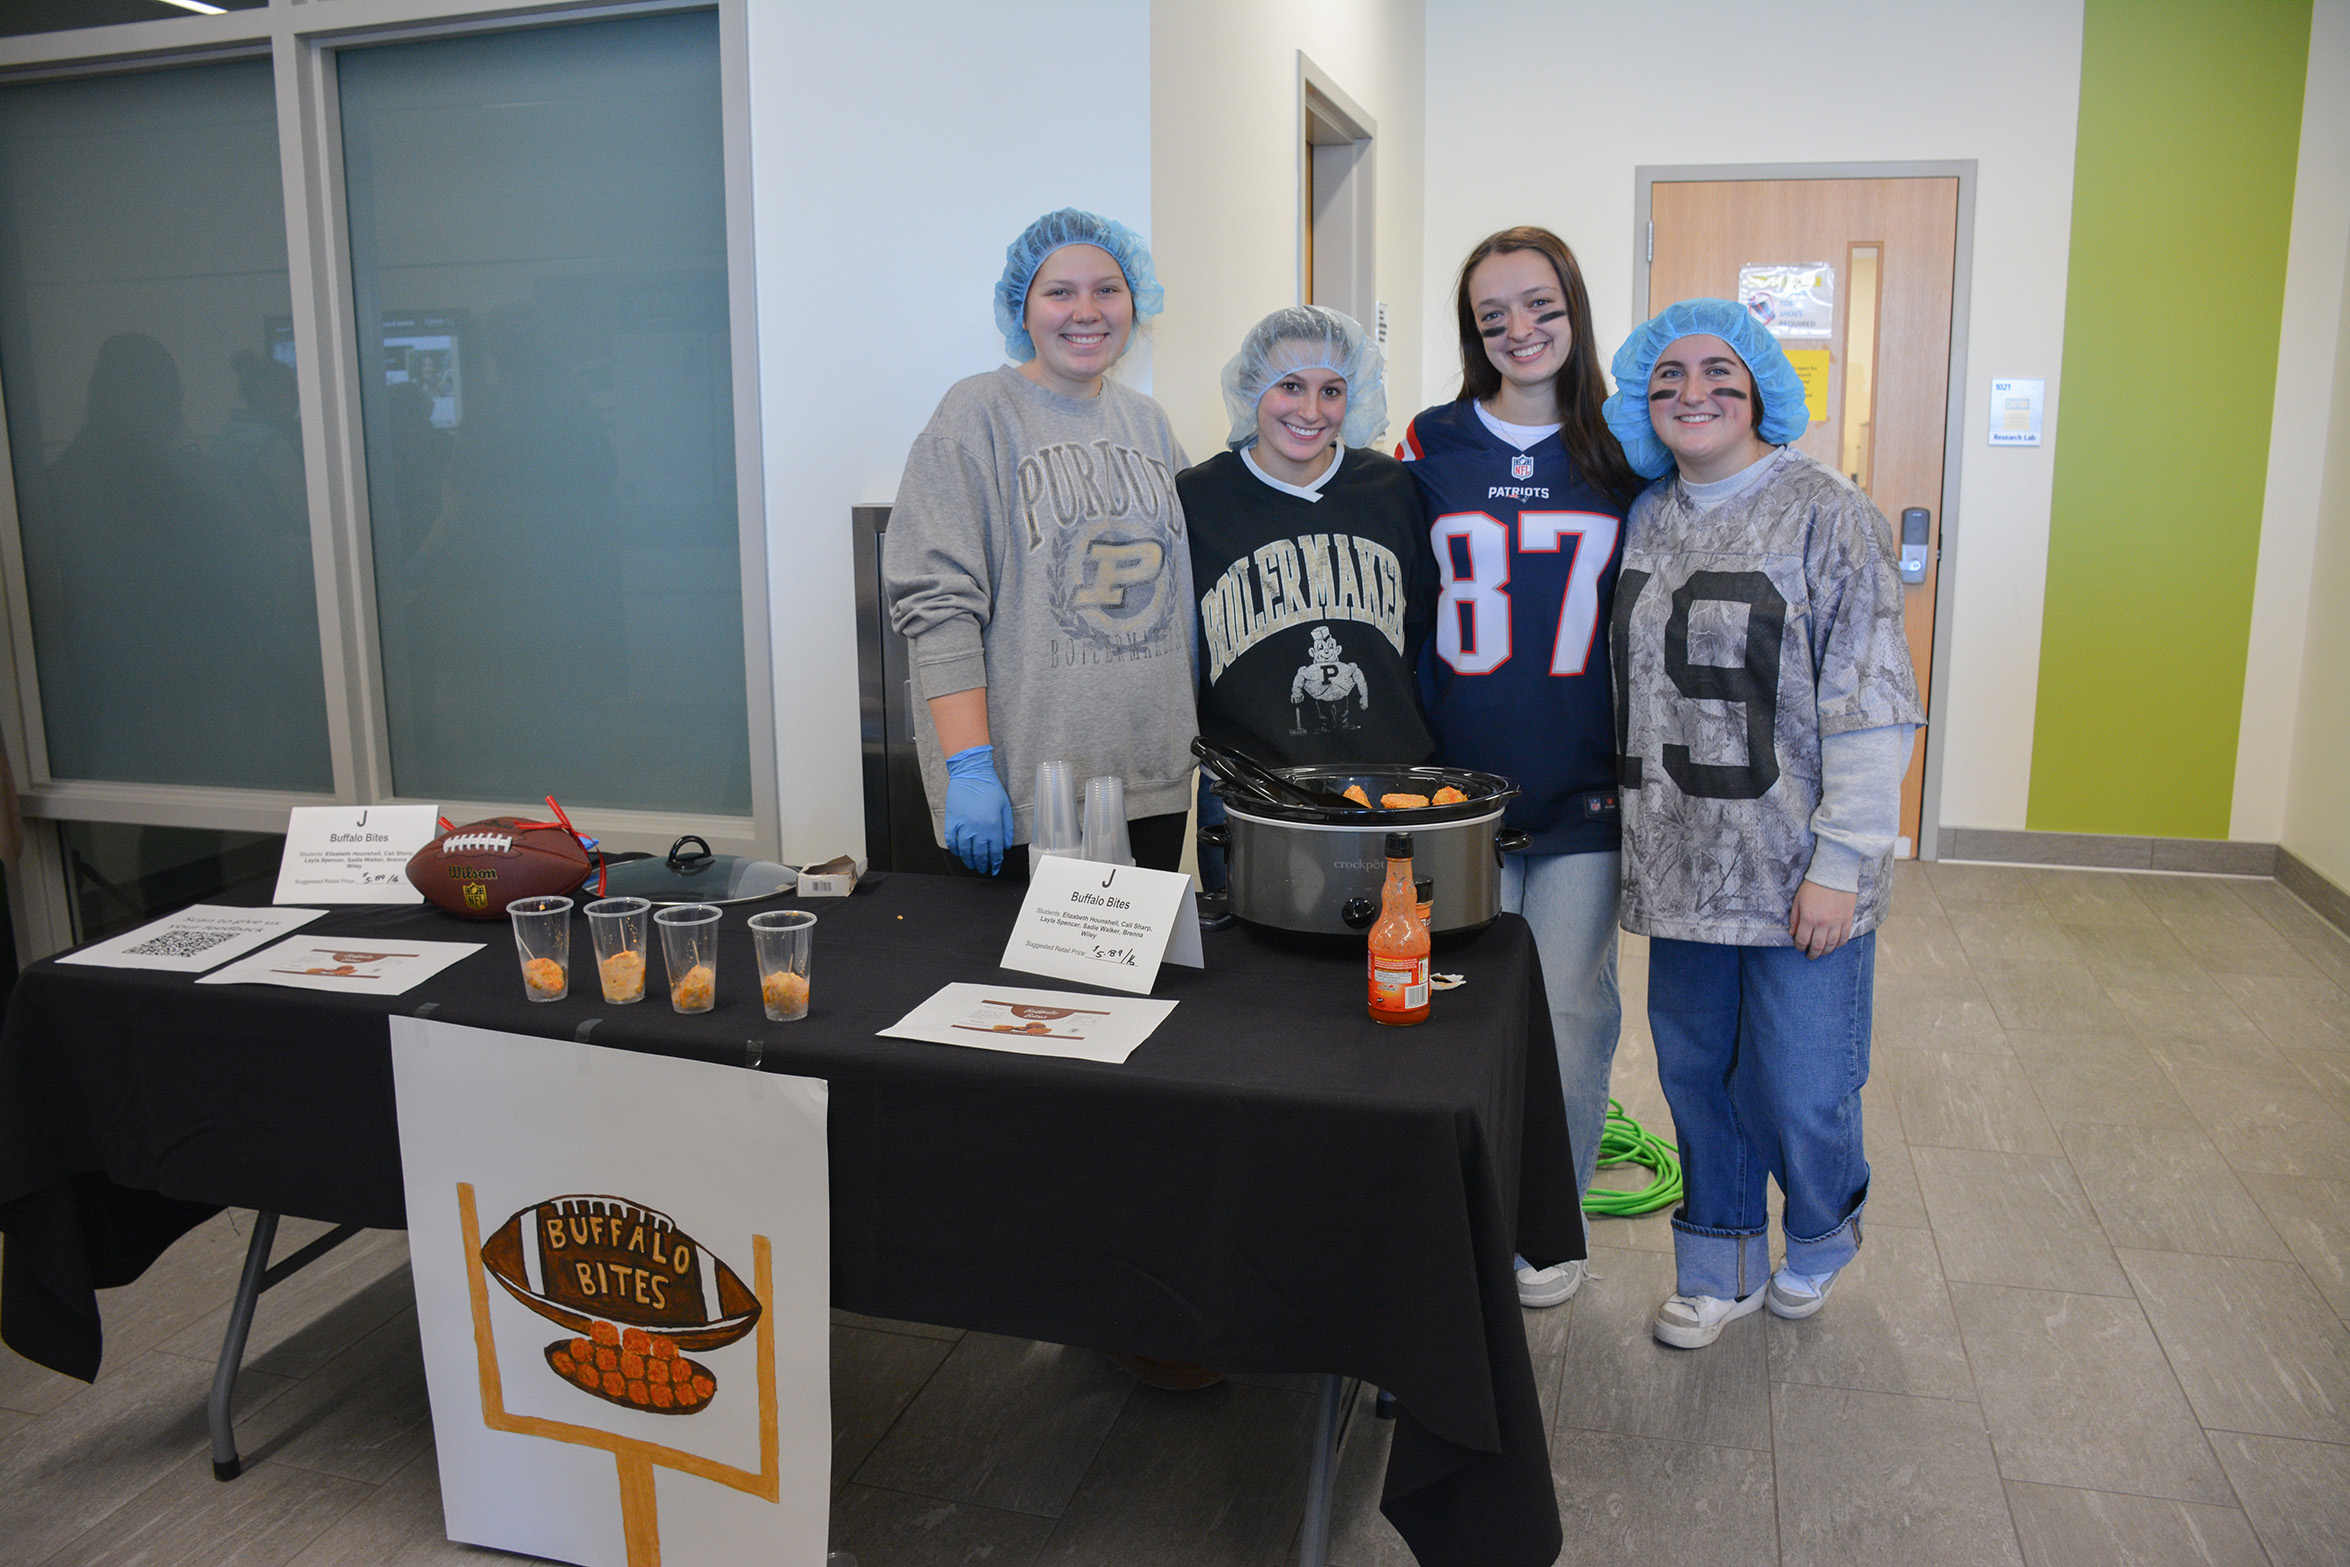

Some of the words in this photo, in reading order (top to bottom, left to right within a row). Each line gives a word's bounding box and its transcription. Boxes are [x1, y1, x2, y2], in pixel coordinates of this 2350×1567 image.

[1778, 320, 1817, 328] REQUIRED
[1995, 383, 2011, 391] 1021
[2023, 433, 2036, 441] Lab
[1514, 465, 1531, 476] NFL
[1488, 486, 1550, 499] PATRIOTS
[1066, 536, 1167, 610] P
[1430, 510, 1621, 677] 87
[1320, 664, 1340, 686] P
[356, 810, 368, 827] J
[330, 833, 363, 843] Buffalo
[365, 833, 389, 843] Bites
[448, 865, 497, 881] Wilson
[1333, 859, 1385, 873] crockpot
[1101, 869, 1116, 888] J
[467, 894, 485, 908] NFL
[1070, 891, 1105, 907] Buffalo
[1106, 896, 1131, 910] Bites
[1036, 907, 1061, 917] Students:
[1062, 911, 1089, 921] Elizabeth
[1089, 917, 1120, 927] Hounshell,
[1121, 921, 1133, 929] Cali
[1134, 923, 1153, 932] Sharp,
[1040, 915, 1056, 924] Layla
[1056, 918, 1081, 929] Spencer,
[1082, 923, 1099, 931] Sadie
[1100, 926, 1121, 936] Walker,
[1122, 929, 1144, 938] Brenna
[1080, 930, 1097, 940] Wiley
[1025, 940, 1054, 951] Suggested
[1055, 945, 1071, 954] Retail
[1071, 948, 1086, 957] Price:
[546, 1216, 691, 1275] BUFFALO
[575, 1262, 669, 1311] BITES
